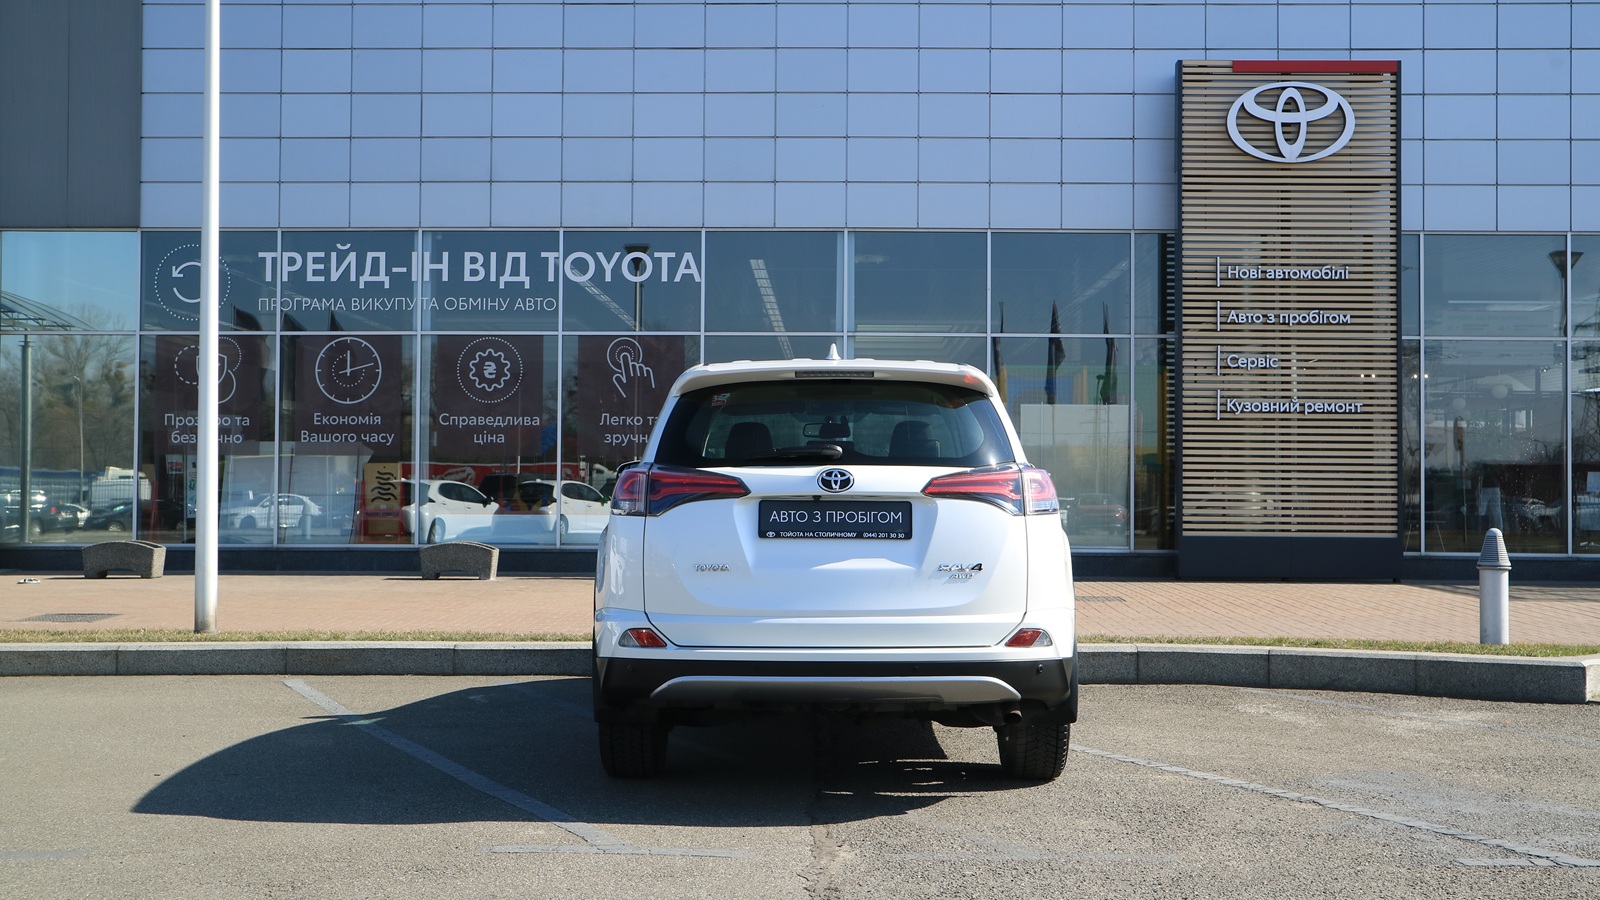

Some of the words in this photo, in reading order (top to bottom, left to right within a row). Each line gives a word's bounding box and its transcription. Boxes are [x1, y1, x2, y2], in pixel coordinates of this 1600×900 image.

[258, 243, 449, 289] ТРЕЙД-ІН
[463, 251, 530, 289] ВІД
[540, 251, 701, 283] TOYOTA
[1227, 265, 1261, 280] Нові
[1266, 265, 1350, 280] автомобілі
[258, 297, 346, 311] ПРОГРАМА
[351, 297, 417, 311] ВИКУПУ
[421, 297, 439, 311] ТА
[444, 297, 510, 311] ОБМІНУ
[514, 297, 557, 311] АВТО
[1227, 310, 1263, 324] Авто
[1266, 312, 1275, 324] з
[1279, 310, 1351, 326] пробігом
[1226, 354, 1279, 371] Сервіс
[1226, 398, 1300, 415] Кузовний
[1304, 402, 1363, 415] ремонт
[164, 413, 231, 429] Проо
[234, 416, 250, 426] та
[313, 412, 381, 425] Економія
[439, 412, 540, 429] Справедлива
[599, 413, 643, 426] Легко
[171, 430, 243, 444] безчно
[300, 430, 357, 443] Вашого
[361, 433, 395, 446] часу
[473, 430, 505, 446] ціна
[604, 433, 649, 447] зручн
[769, 510, 808, 523] АВТО
[826, 511, 902, 524] ПРОБІГОМ
[694, 564, 730, 572] TOYOTA
